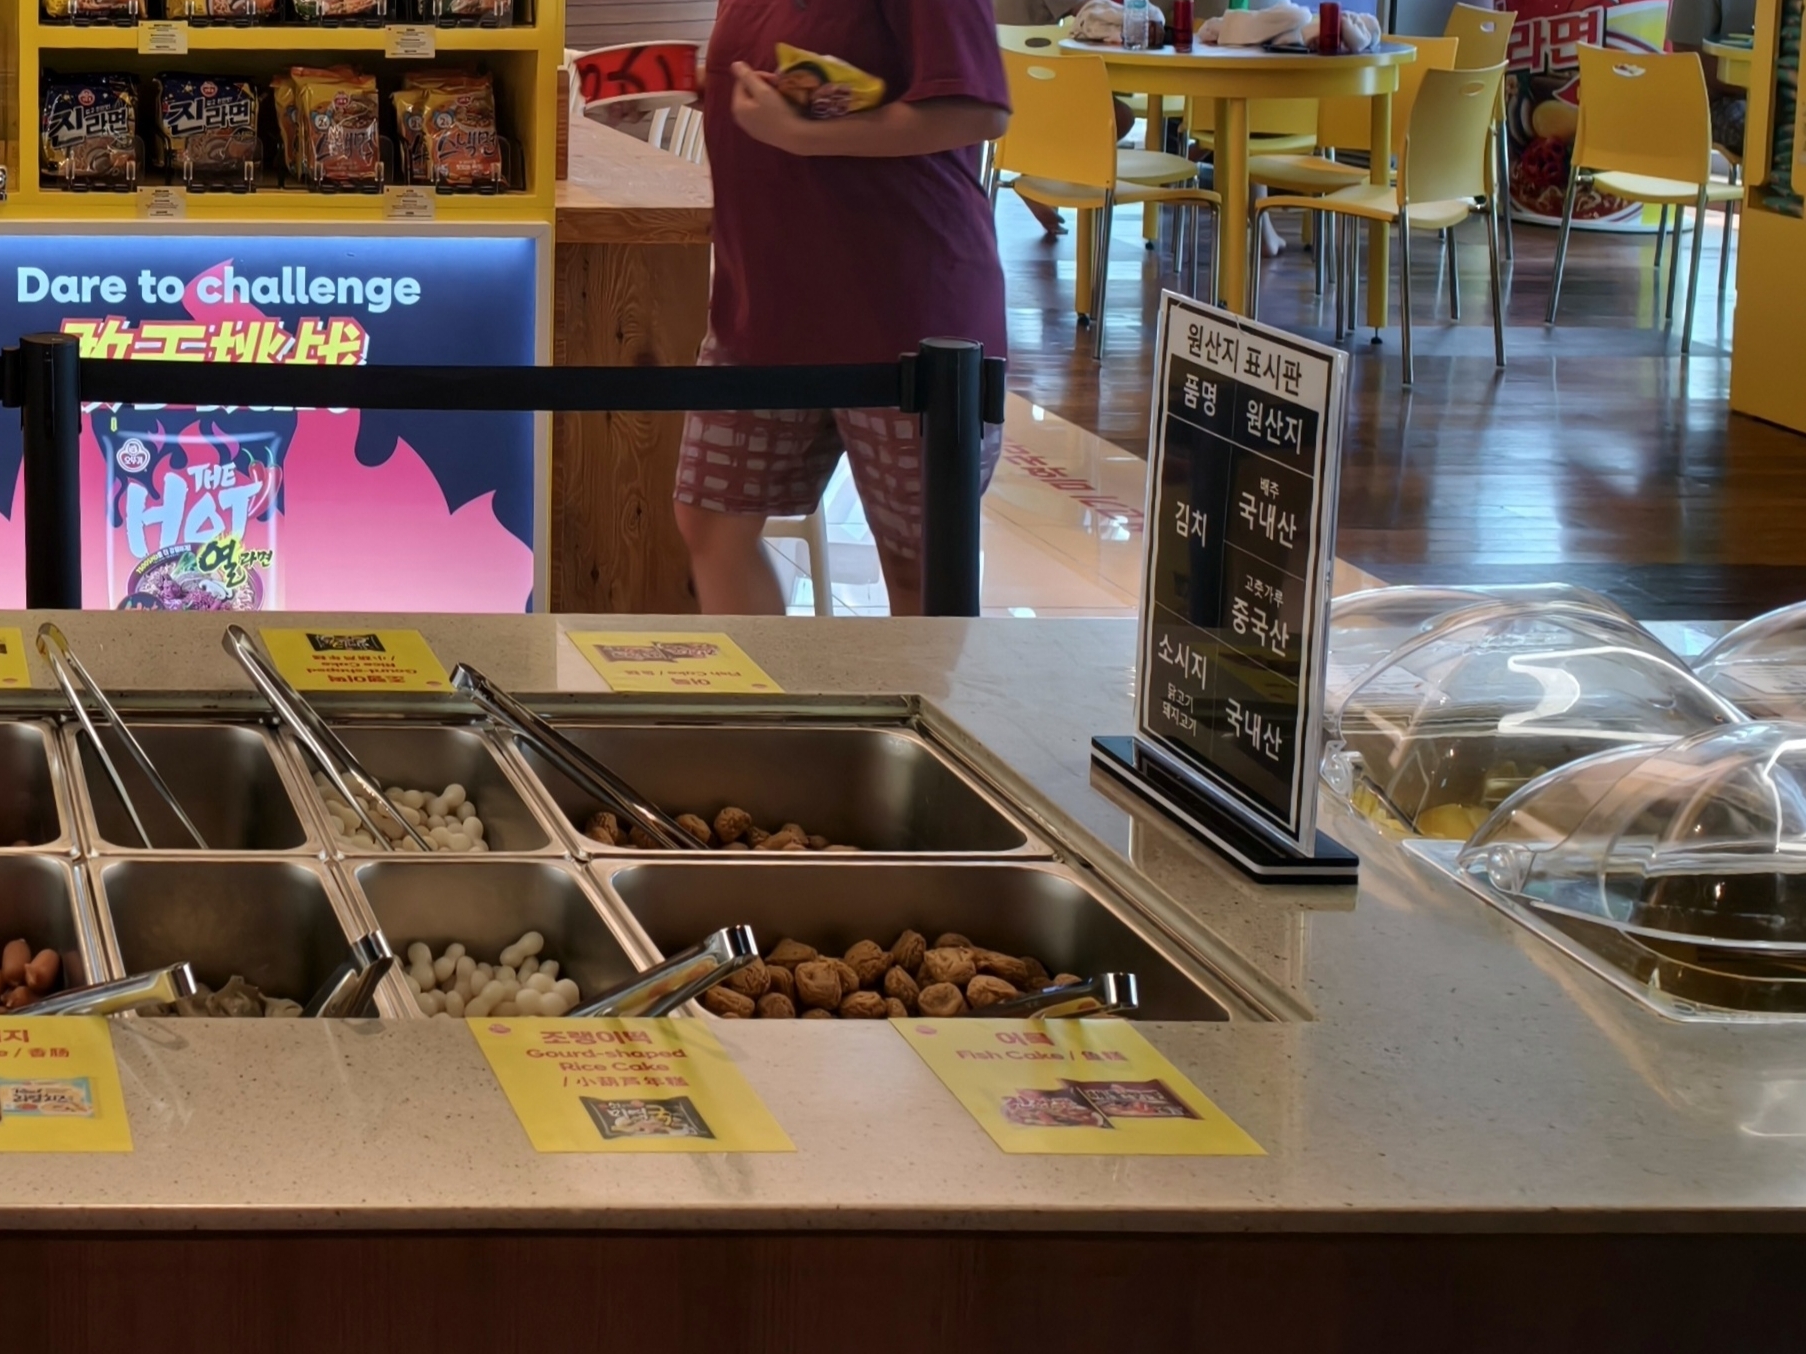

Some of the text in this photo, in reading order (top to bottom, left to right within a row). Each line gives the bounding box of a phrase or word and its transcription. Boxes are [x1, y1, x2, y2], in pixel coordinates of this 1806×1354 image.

[49, 105, 131, 150] 진라면
[164, 97, 251, 137] 진라면
[17, 266, 422, 314] Dare to challenge
[1187, 322, 1303, 396] 원산지 표시판
[1183, 372, 1218, 418] 품명
[1246, 399, 1303, 455] 원산지
[122, 454, 144, 465] 오뚜기
[187, 461, 236, 491] THE
[125, 472, 263, 559] HOT
[1175, 501, 1207, 549] 김치
[1238, 491, 1298, 550] 국내산
[197, 539, 245, 588] 열
[238, 548, 273, 568] 라면
[1244, 574, 1284, 608] 고춧가루
[1231, 596, 1290, 658] 중국산
[1158, 633, 1207, 691] 소시지
[1162, 700, 1197, 738] 돼지고기
[1167, 681, 1194, 715] 닭고기
[1225, 698, 1283, 761] 국내산
[526, 1048, 688, 1060] Gourd-shaped
[558, 1062, 670, 1071] Rice Cake
[956, 1050, 1001, 1060] Fish
[1005, 1050, 1065, 1061] Cake
